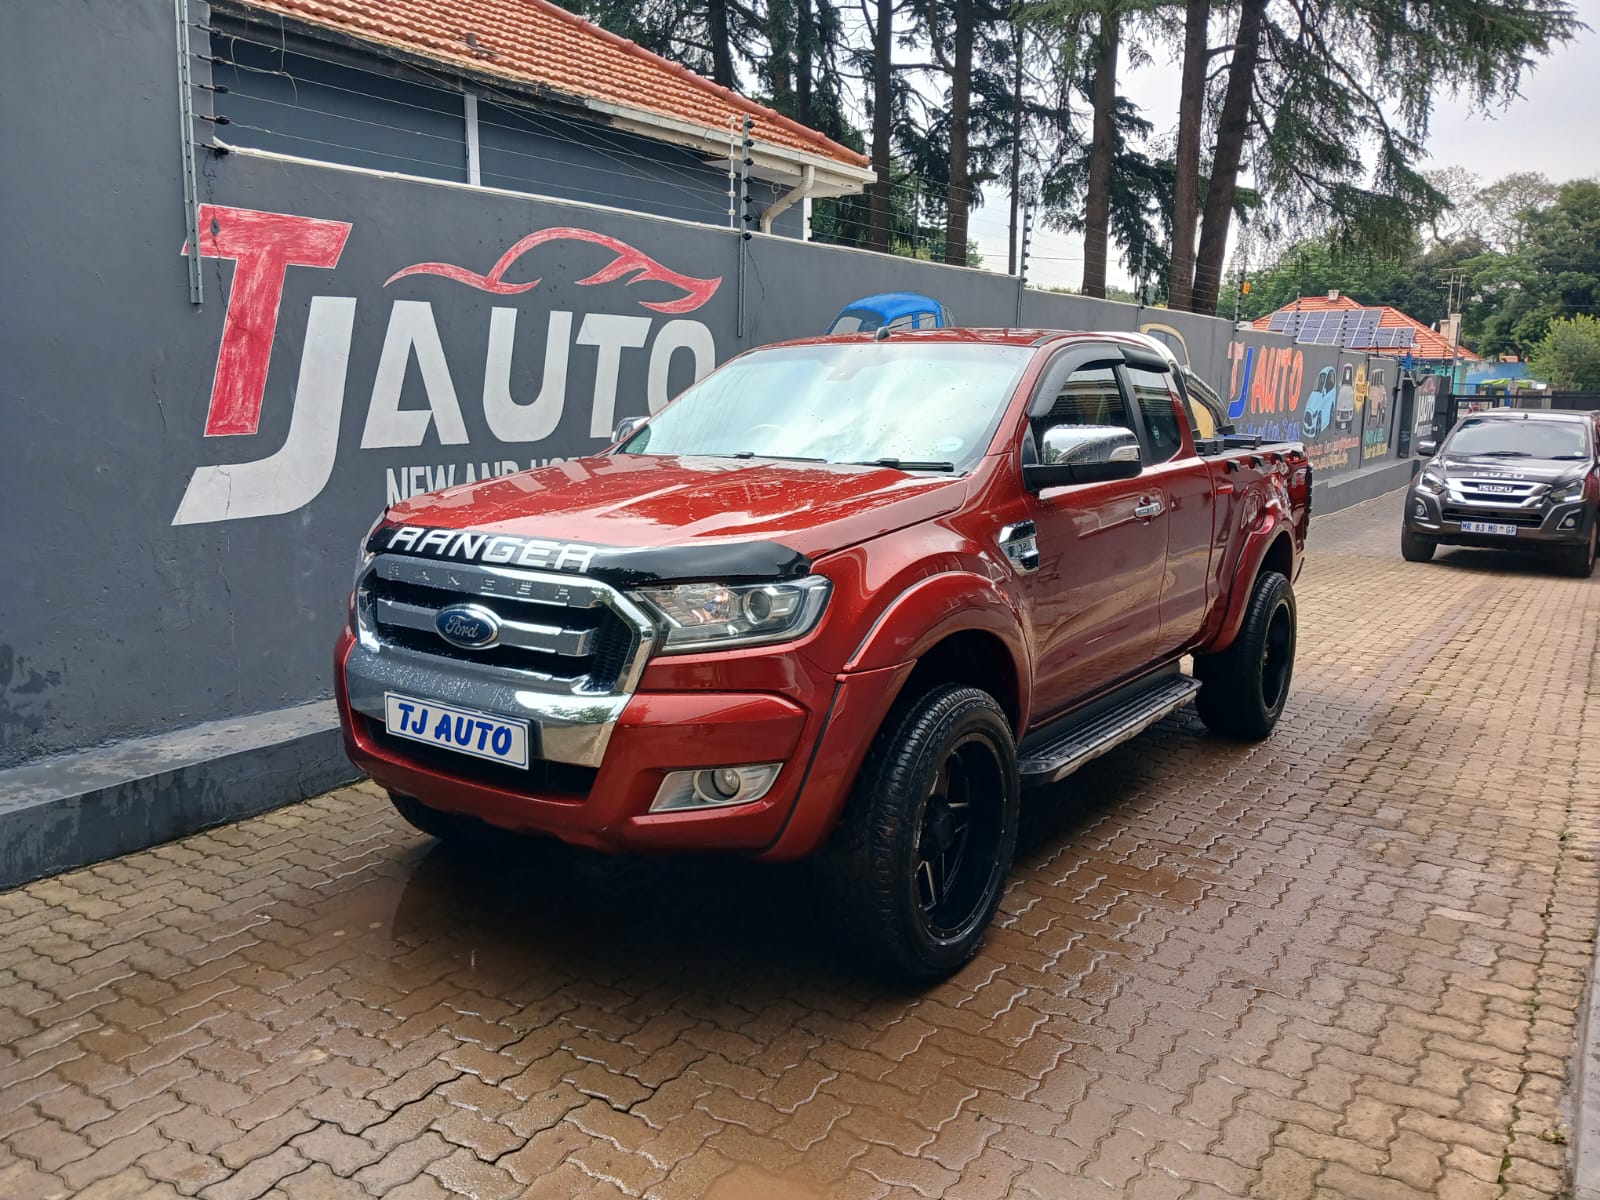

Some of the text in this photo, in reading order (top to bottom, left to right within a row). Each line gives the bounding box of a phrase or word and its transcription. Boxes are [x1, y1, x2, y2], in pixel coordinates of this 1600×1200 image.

[360, 300, 717, 450] AUTO
[1250, 344, 1304, 414] AUTO
[386, 463, 456, 507] NEW
[1478, 485, 1513, 493] ISUZU
[387, 527, 597, 572] RANGER
[444, 614, 481, 639] Ford
[398, 703, 513, 757] TJ AUTO
